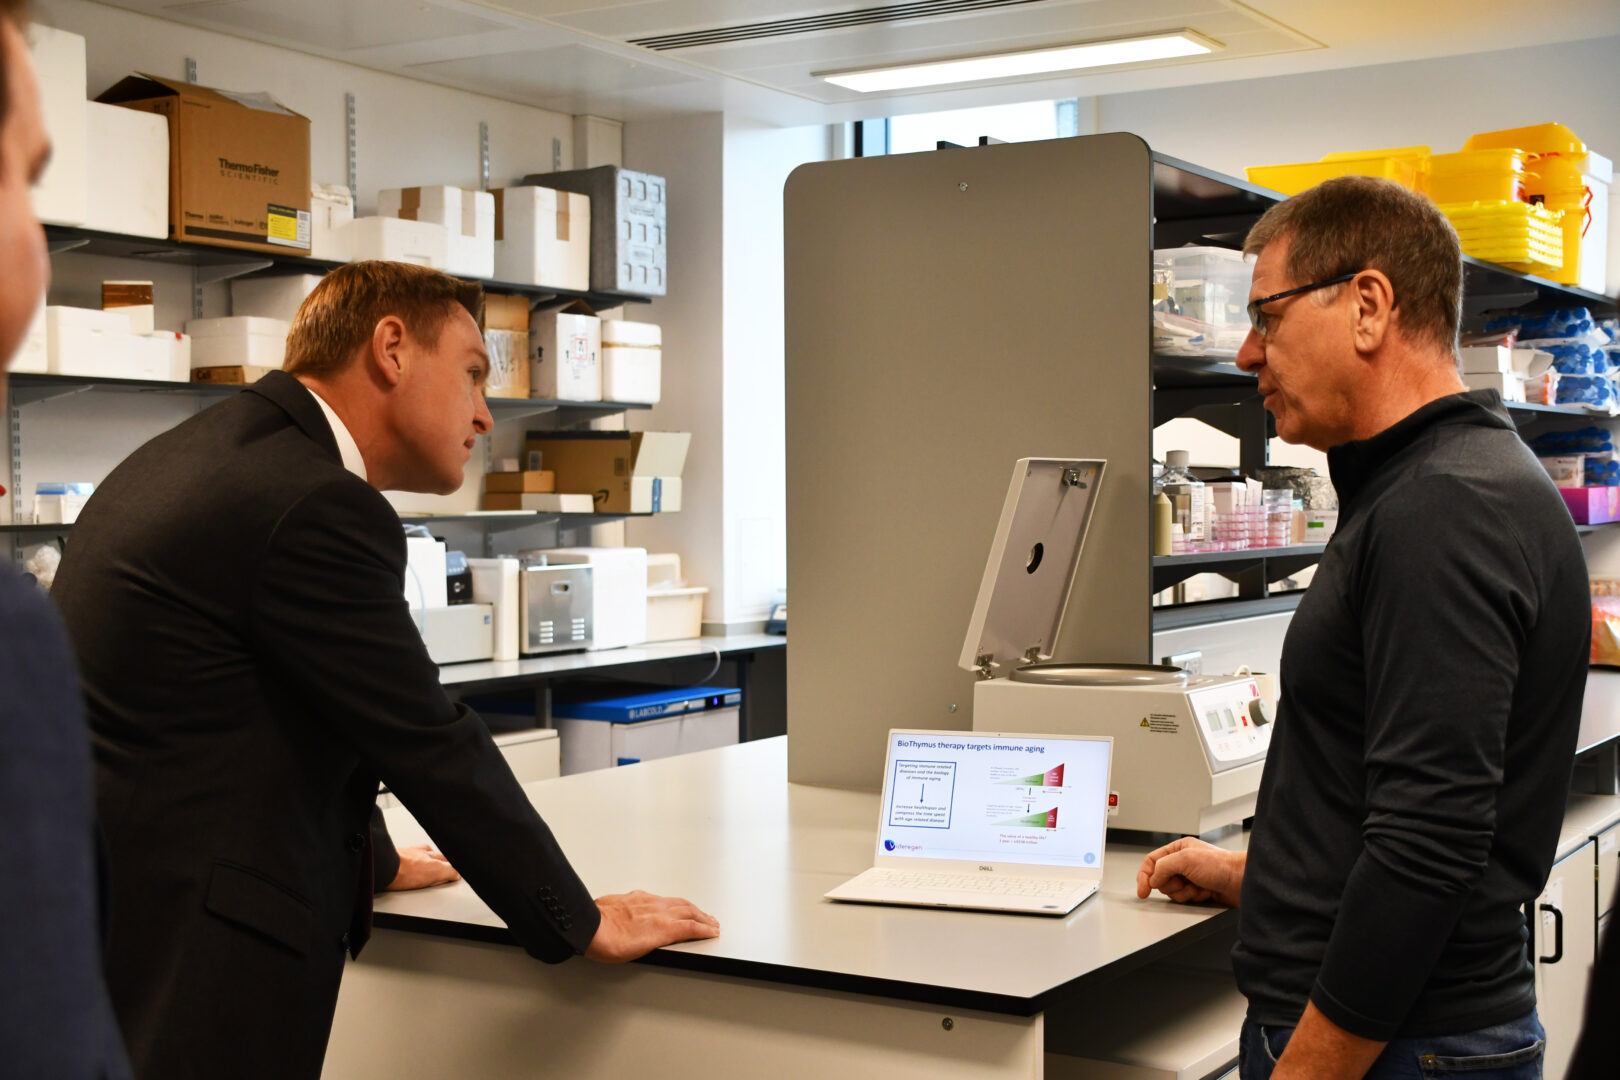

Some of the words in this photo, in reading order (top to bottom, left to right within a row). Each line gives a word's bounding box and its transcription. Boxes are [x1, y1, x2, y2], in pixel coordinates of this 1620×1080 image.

[219, 157, 280, 177] ThermoFisher
[220, 169, 279, 185] SCIENTIFIC
[635, 705, 663, 719] LABCOLD
[897, 739, 937, 749] BioThymus
[938, 741, 965, 751] therapy
[966, 743, 992, 752] targets
[993, 744, 1024, 752] immune
[1025, 745, 1045, 753] aging
